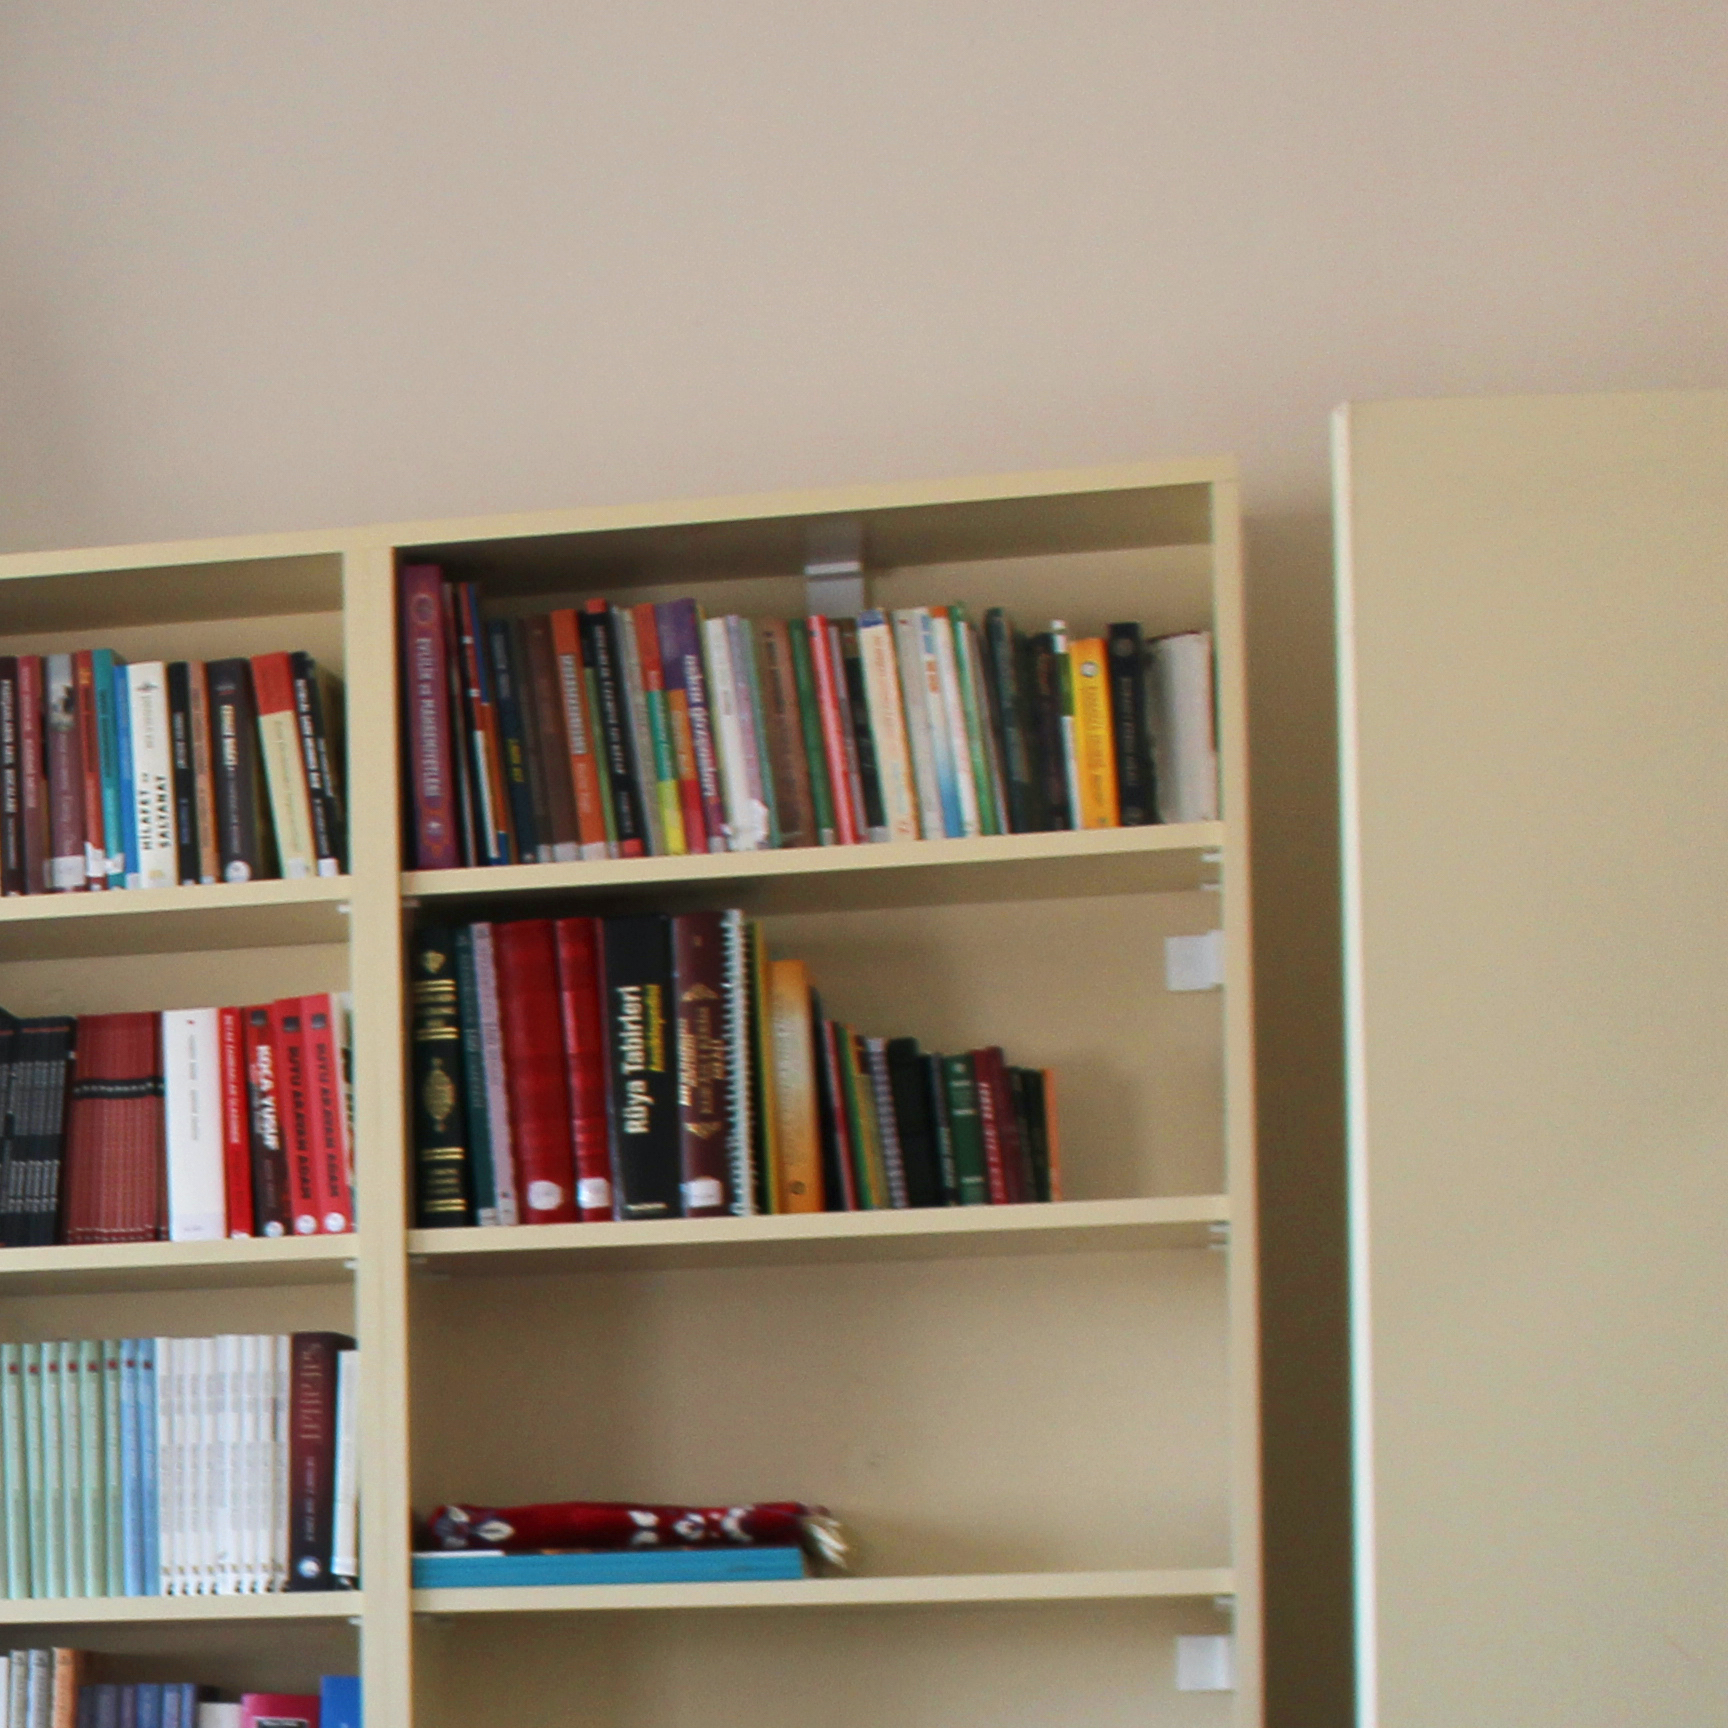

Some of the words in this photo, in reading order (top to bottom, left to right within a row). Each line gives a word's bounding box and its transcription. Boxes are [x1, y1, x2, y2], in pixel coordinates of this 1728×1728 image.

[156, 775, 170, 848] SALTANAT
[617, 985, 645, 1075] Tabirleri
[255, 1044, 275, 1091] KOCA
[261, 1095, 281, 1151] YUSUF
[621, 1080, 654, 1134] Rüya
